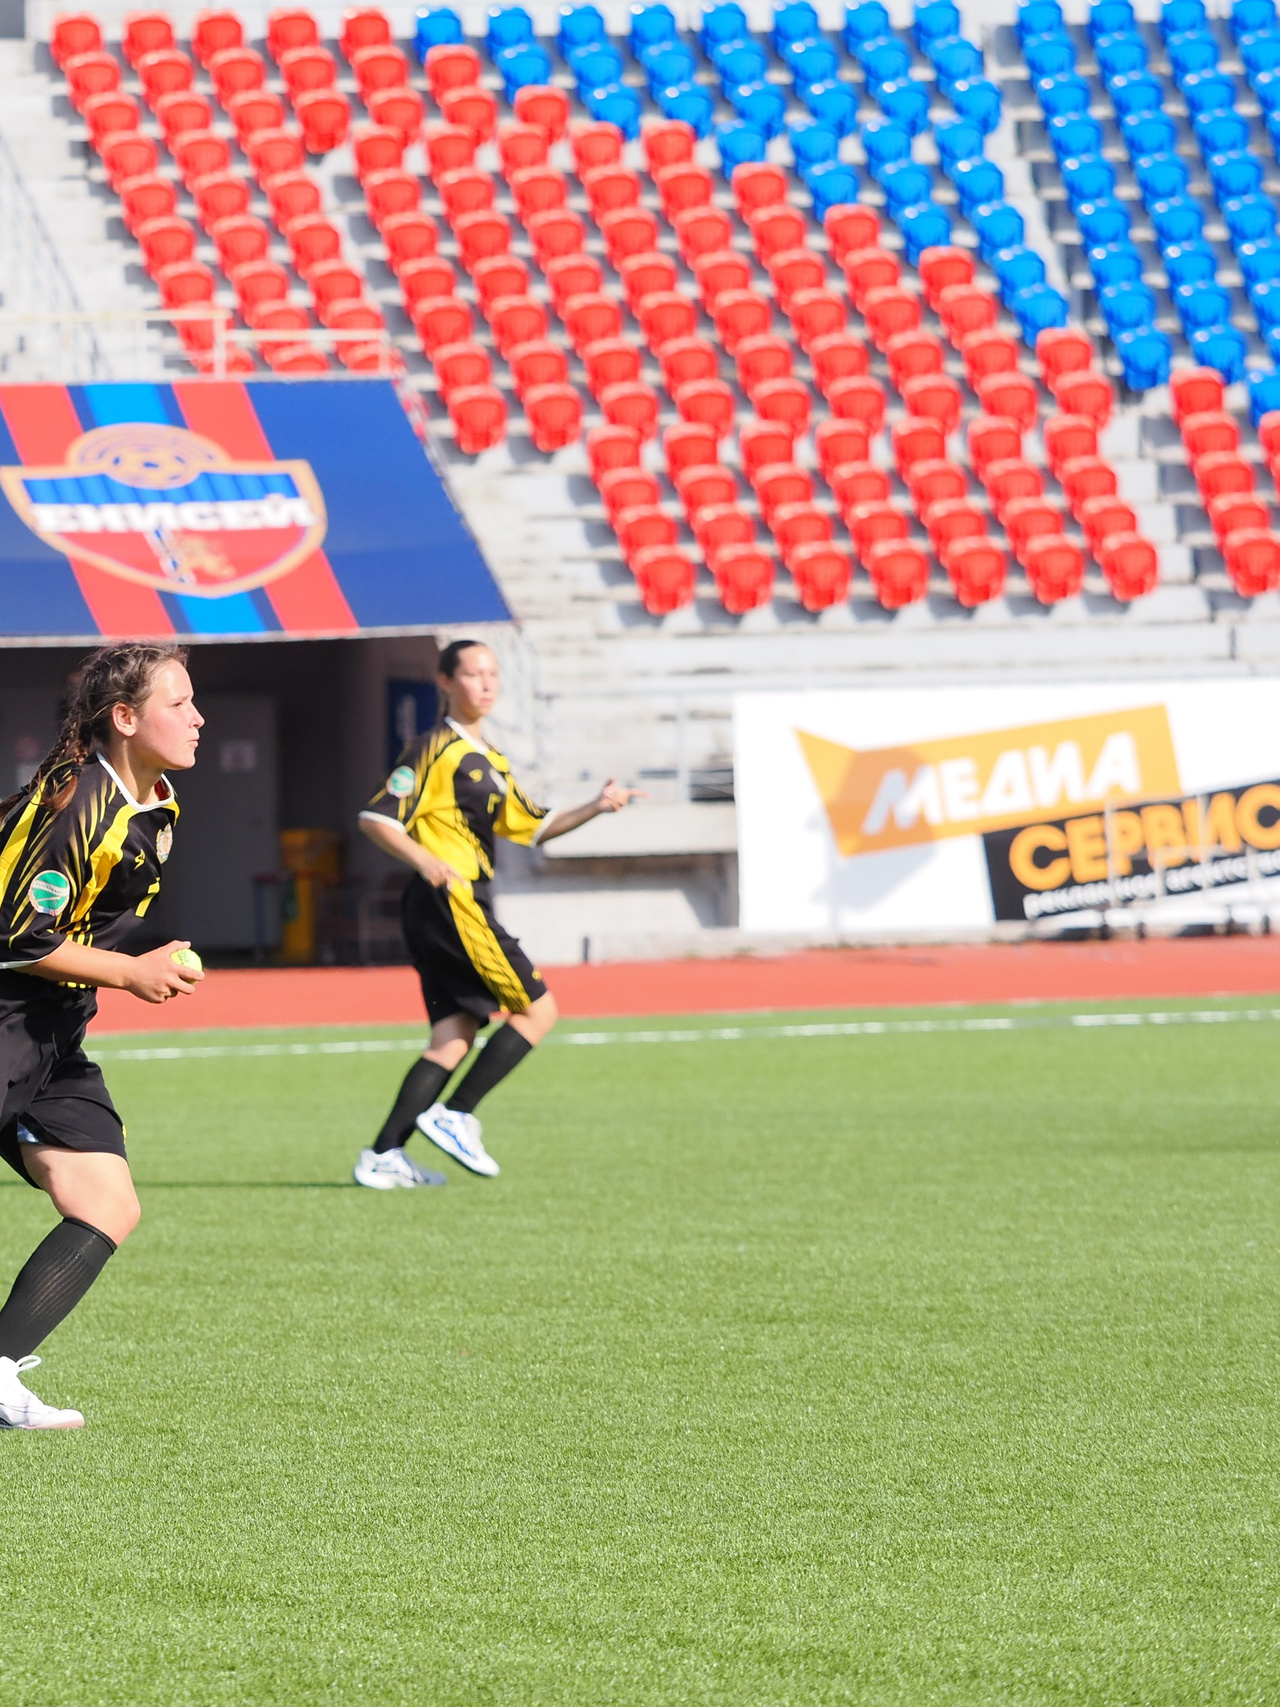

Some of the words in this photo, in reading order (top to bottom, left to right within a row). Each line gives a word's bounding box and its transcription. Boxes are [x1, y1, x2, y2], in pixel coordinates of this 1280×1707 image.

[31, 493, 316, 532] ЕНИСЕЙ
[861, 730, 1142, 836] МЕДИА
[1008, 783, 1280, 891] СЕРВИС
